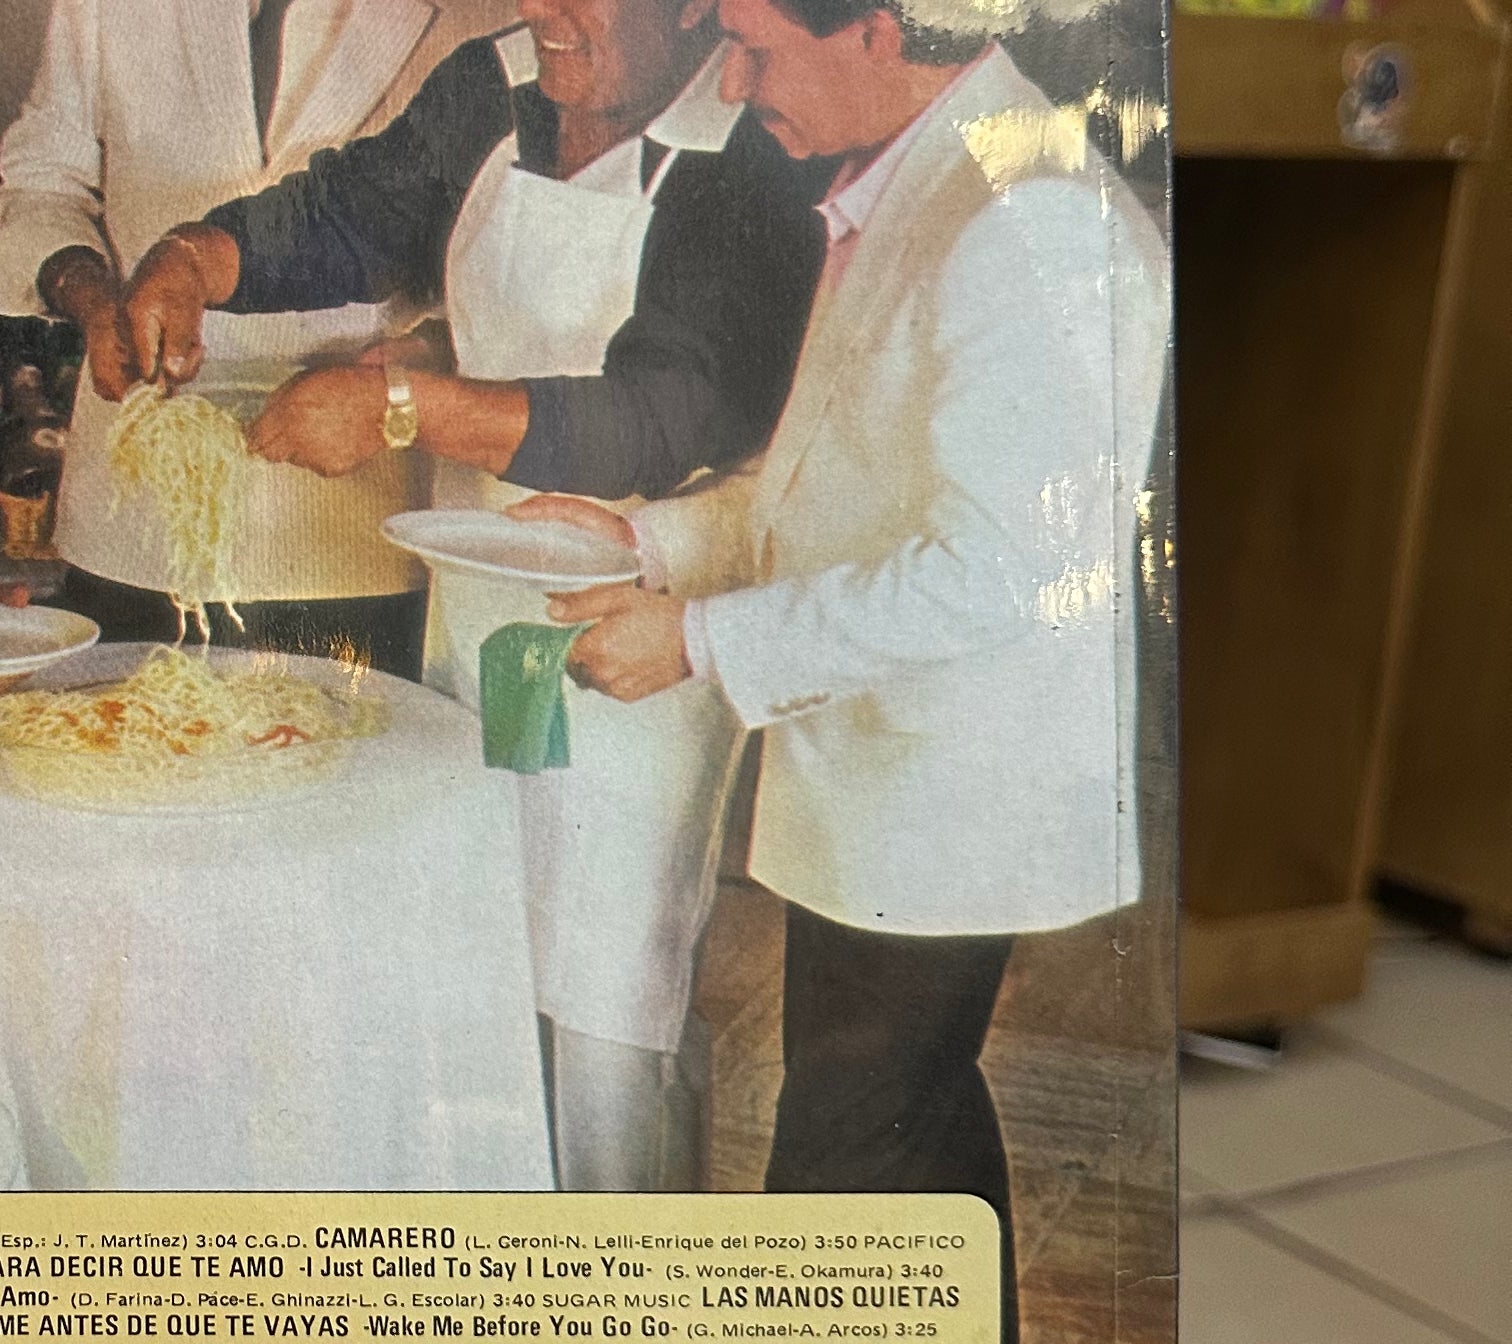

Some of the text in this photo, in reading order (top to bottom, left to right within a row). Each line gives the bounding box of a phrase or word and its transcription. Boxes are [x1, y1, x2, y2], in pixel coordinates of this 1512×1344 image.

[315, 1226, 456, 1250] CAMARERO
[50, 1255, 123, 1278] DECIR
[132, 1255, 182, 1278] QUE
[190, 1255, 221, 1279] TE
[228, 1255, 284, 1279] AMO
[320, 1255, 364, 1278] Just
[372, 1255, 436, 1279] Called
[442, 1256, 472, 1279] To
[479, 1255, 517, 1283] Say
[526, 1256, 533, 1278] I
[542, 1256, 593, 1280] Love
[600, 1255, 653, 1279] You-
[0, 1285, 59, 1308] Amo-
[702, 1285, 960, 1310] LAS MANOS QUIETAS
[38, 1313, 119, 1337] ANTES
[127, 1314, 158, 1337] DE
[166, 1313, 217, 1337] QUE
[224, 1314, 255, 1337] TE
[263, 1314, 349, 1338] VAYAS
[363, 1314, 426, 1338] -Wake
[432, 1314, 464, 1337] Me
[472, 1314, 541, 1338] Before
[548, 1314, 593, 1337] You
[602, 1315, 632, 1338] Go
[640, 1315, 678, 1338] Go-
